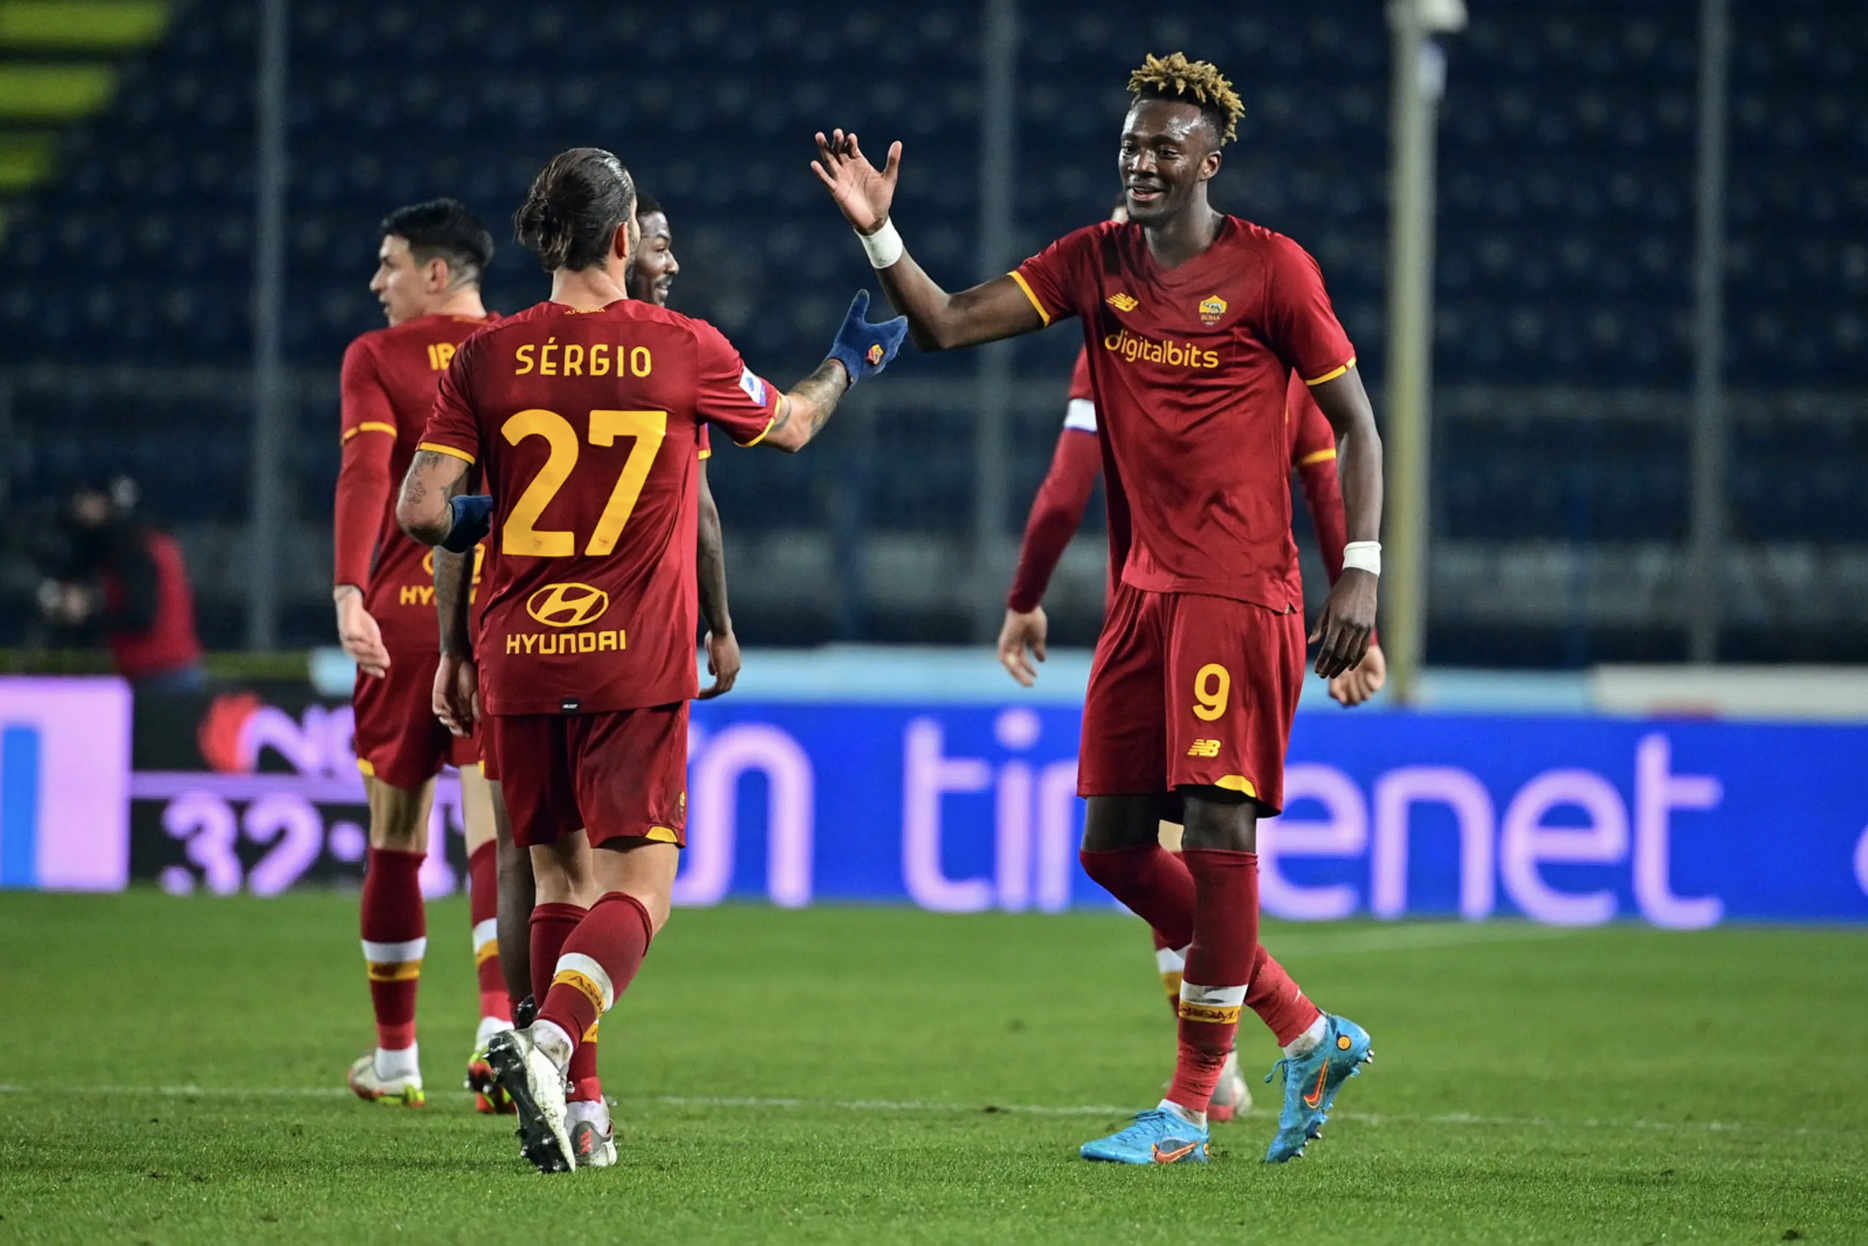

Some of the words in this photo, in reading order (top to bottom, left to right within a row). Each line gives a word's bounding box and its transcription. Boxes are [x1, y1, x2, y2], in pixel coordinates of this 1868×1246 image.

[427, 342, 464, 371] IB
[515, 337, 652, 377] SÉRGIO
[1104, 328, 1219, 369] digitalbits
[501, 408, 667, 557] 27
[506, 629, 627, 655] HYUNDAI
[1192, 663, 1231, 722] 9
